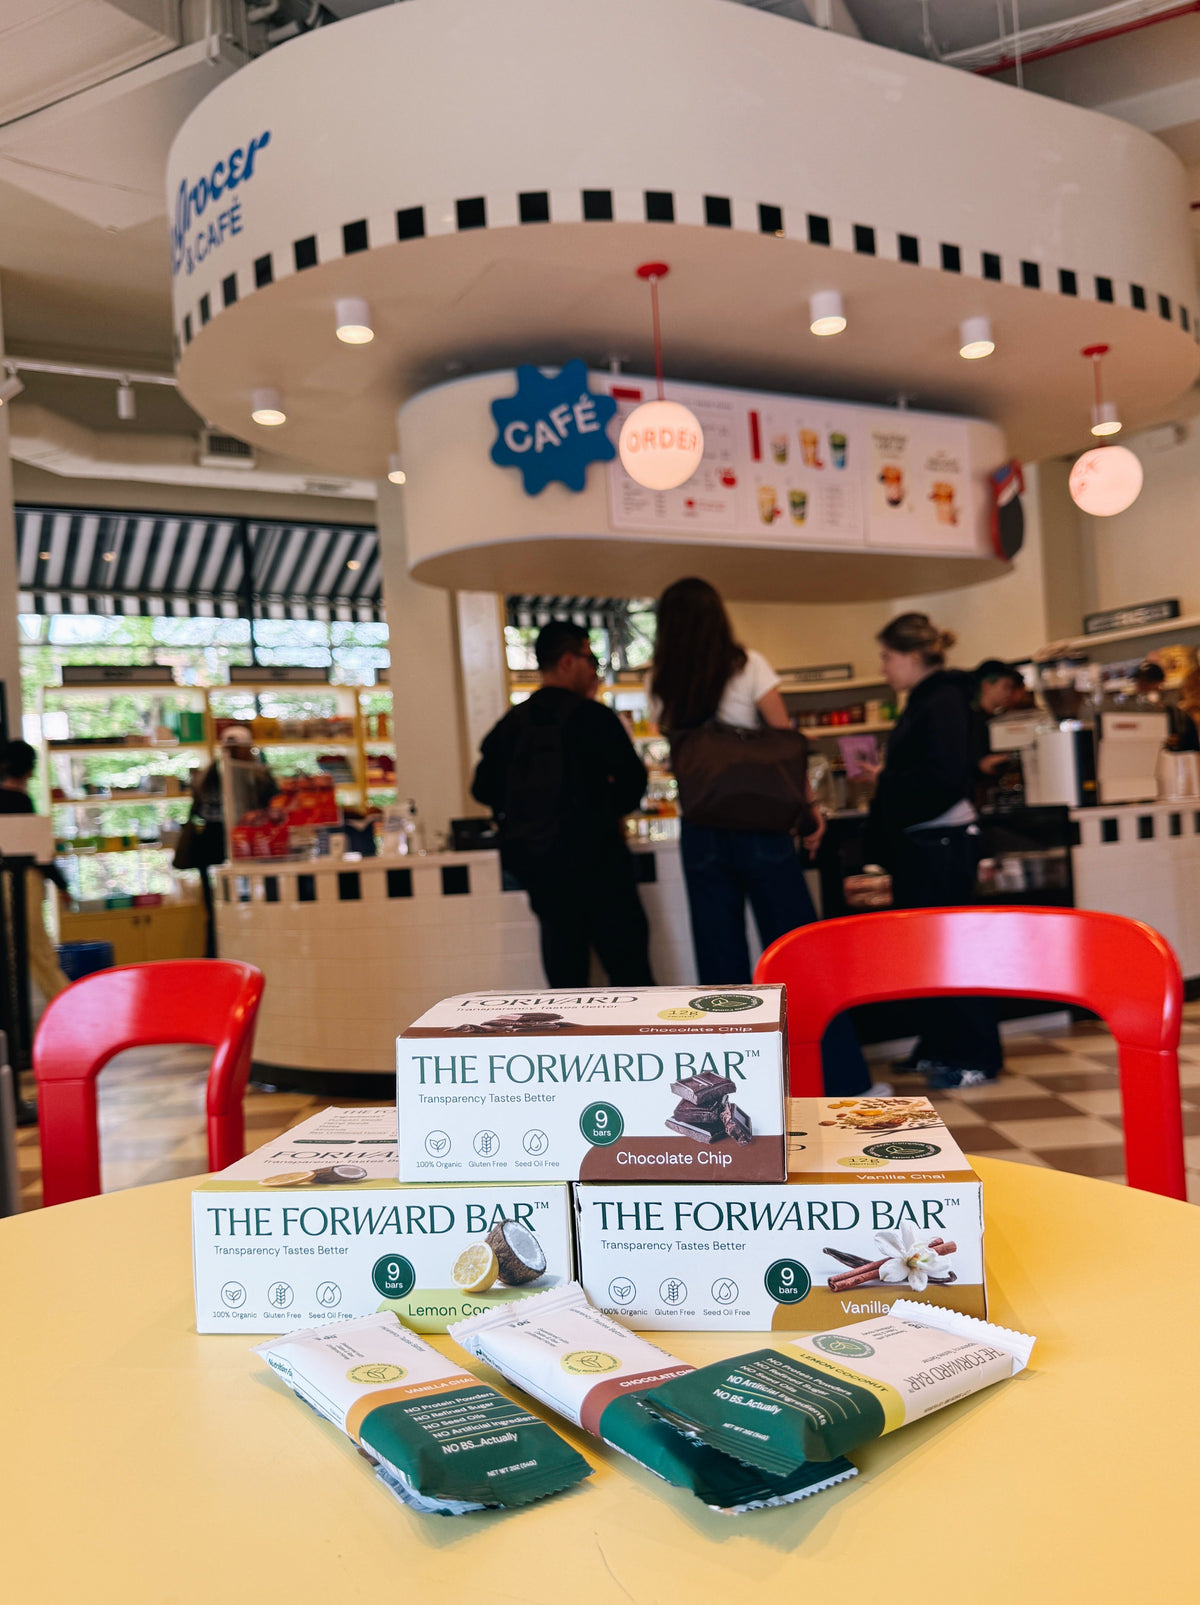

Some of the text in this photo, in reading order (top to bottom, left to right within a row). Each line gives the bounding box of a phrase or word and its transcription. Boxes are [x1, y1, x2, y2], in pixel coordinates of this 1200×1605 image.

[503, 393, 600, 453] CAFÉ
[460, 995, 638, 1007] FORWARD
[411, 1056, 478, 1084] THE
[488, 1053, 664, 1084] FORWARD
[418, 1092, 556, 1105] Transparency Tastes Better
[594, 1110, 608, 1128] 9
[593, 1128, 612, 1137] bars
[270, 1151, 398, 1159] FORWA
[616, 1150, 733, 1167] Chocolate Chip
[416, 1160, 462, 1169] 100% Organic
[468, 1160, 508, 1168] Gluten Free
[514, 1160, 560, 1168] Seed Oil Free
[207, 1208, 272, 1236] THE
[282, 1205, 456, 1236] FORWARD
[592, 1202, 664, 1231] THE
[674, 1200, 860, 1231] FORWARD
[214, 1245, 348, 1257] Transparency Tastes Better
[601, 1240, 746, 1252] Transparency Tastes Better
[387, 1262, 400, 1280] 9
[781, 1267, 795, 1286] 9
[385, 1280, 404, 1289] bars
[778, 1286, 798, 1294] bars
[408, 1303, 457, 1317] Lemon
[620, 1308, 648, 1318] Organic
[654, 1308, 696, 1316] Gluten Free
[703, 1308, 751, 1316] Seed Oil Free
[840, 1300, 890, 1314] Vanilla
[232, 1311, 258, 1320] Organic
[740, 1365, 798, 1394] NO Seed Oils
[753, 1361, 830, 1396] NO Refined Sugar
[766, 1357, 853, 1396] NO Protein Powders
[800, 1353, 889, 1393] LEMON COCONUT
[619, 1373, 675, 1388] CHOCOLATE
[404, 1382, 448, 1394] VANILLA
[712, 1388, 730, 1400] NO
[404, 1392, 496, 1414] NO Protein Powders
[726, 1374, 827, 1426] NO Artificial Ingredients
[412, 1402, 494, 1422] NO Refined Sugar
[422, 1414, 486, 1430] NO Seed Oils
[432, 1431, 450, 1439] NO
[452, 1422, 490, 1434] Artificial
[442, 1443, 460, 1454] NO
